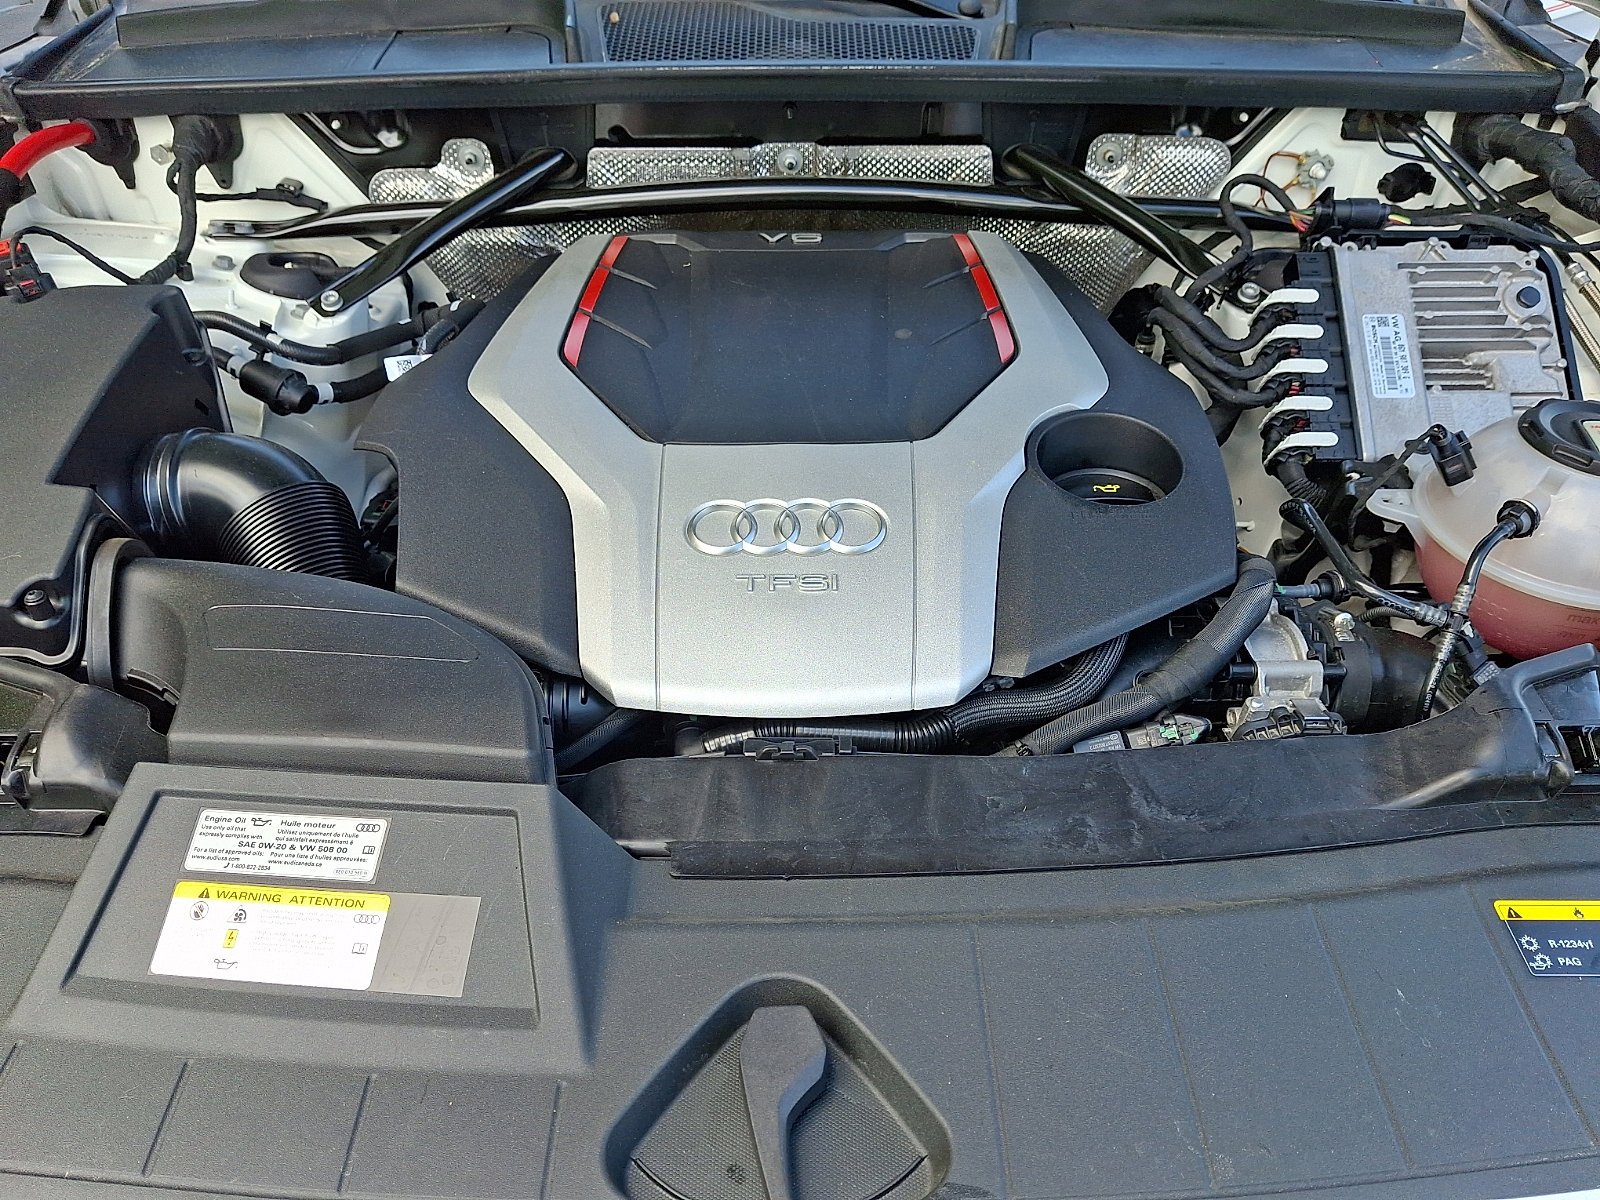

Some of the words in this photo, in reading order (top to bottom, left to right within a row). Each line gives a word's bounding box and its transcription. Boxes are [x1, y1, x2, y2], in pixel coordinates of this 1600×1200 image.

[1393, 330, 1402, 342] AG
[735, 573, 839, 592] TFSI
[204, 815, 233, 824] Engine
[216, 890, 282, 903] WARNING
[288, 894, 366, 908] ATTENTION
[1547, 940, 1594, 950] R-1234yf
[1557, 957, 1582, 966] PAG
